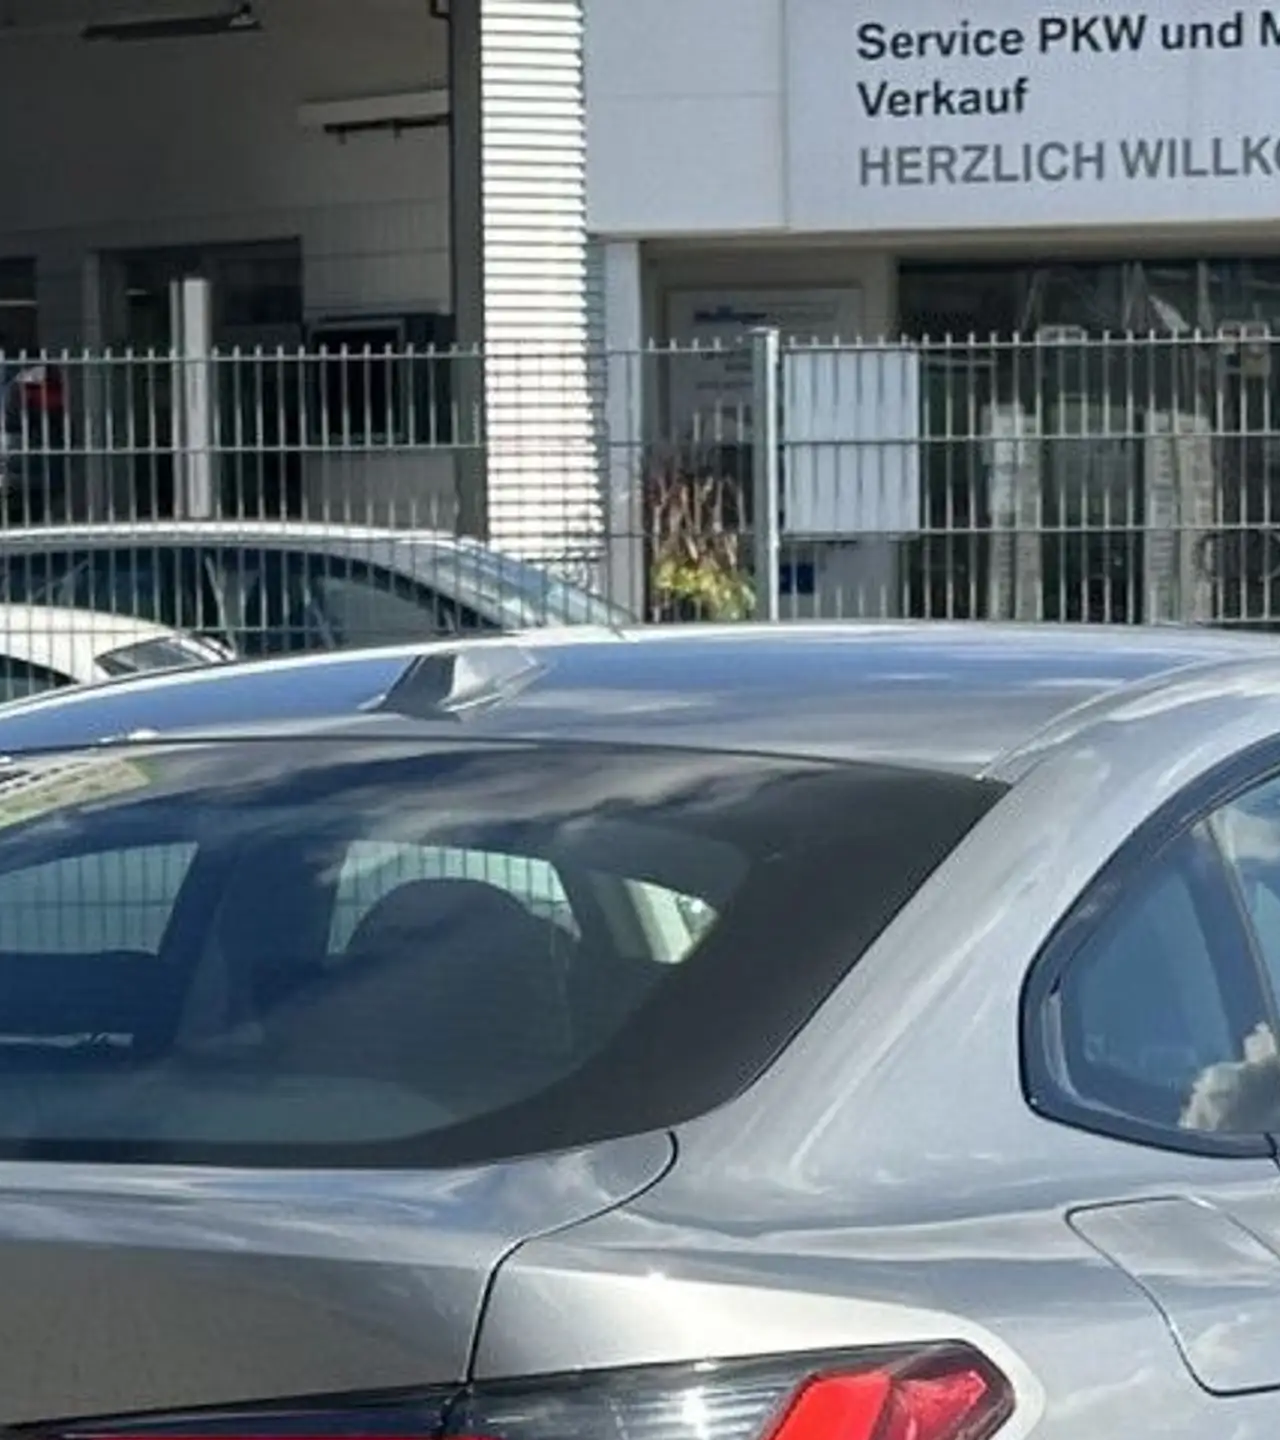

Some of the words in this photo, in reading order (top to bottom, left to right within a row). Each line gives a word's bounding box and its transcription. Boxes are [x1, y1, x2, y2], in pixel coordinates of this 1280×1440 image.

[856, 22, 1024, 60] Service
[1038, 15, 1147, 54] PKW
[1160, 11, 1242, 50] und
[857, 77, 1028, 118] Verkauf
[859, 140, 1104, 186] HERZLICH
